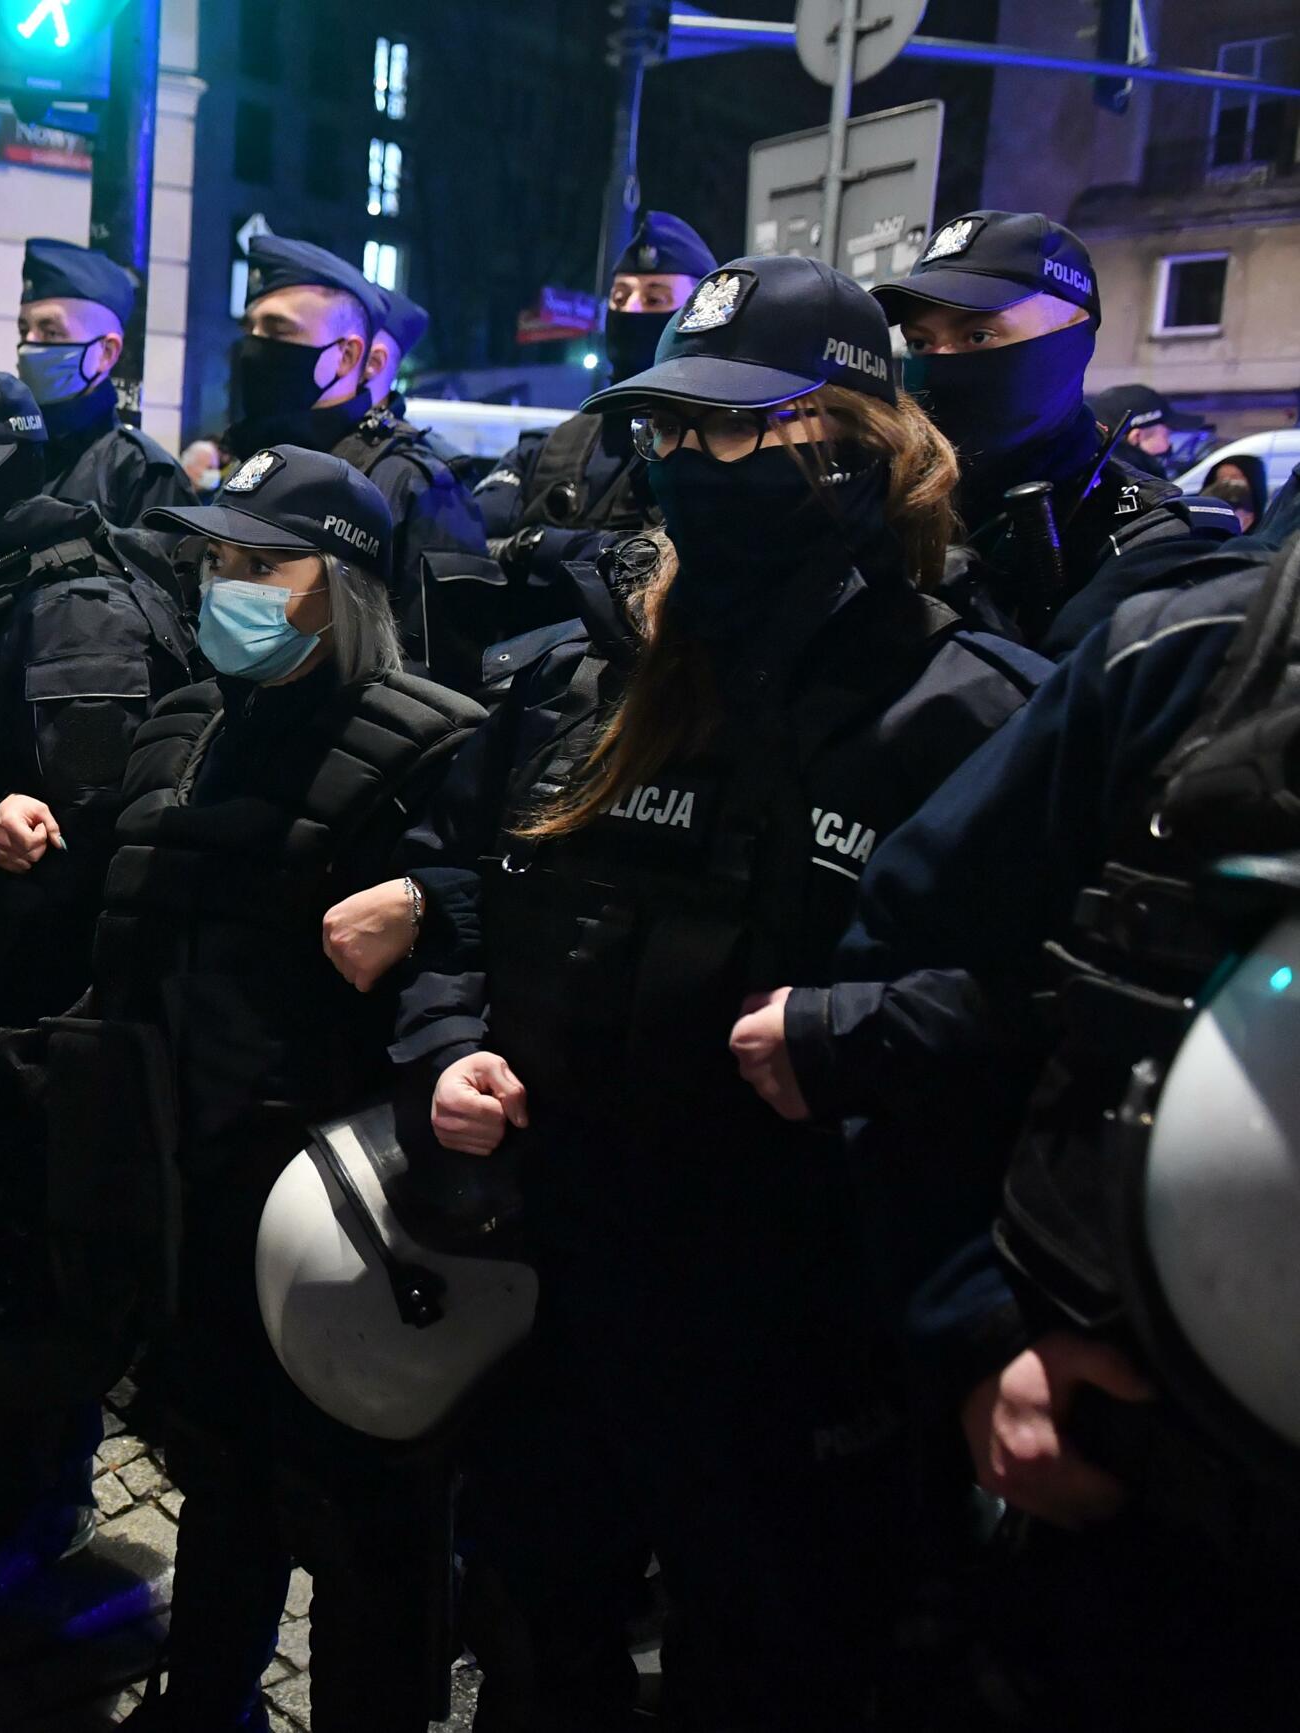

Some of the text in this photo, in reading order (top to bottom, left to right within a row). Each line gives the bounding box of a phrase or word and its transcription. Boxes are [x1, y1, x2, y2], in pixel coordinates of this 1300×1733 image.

[1043, 257, 1093, 297] POLICJA
[822, 337, 888, 381] POLICJA
[323, 514, 381, 559] POLICJA
